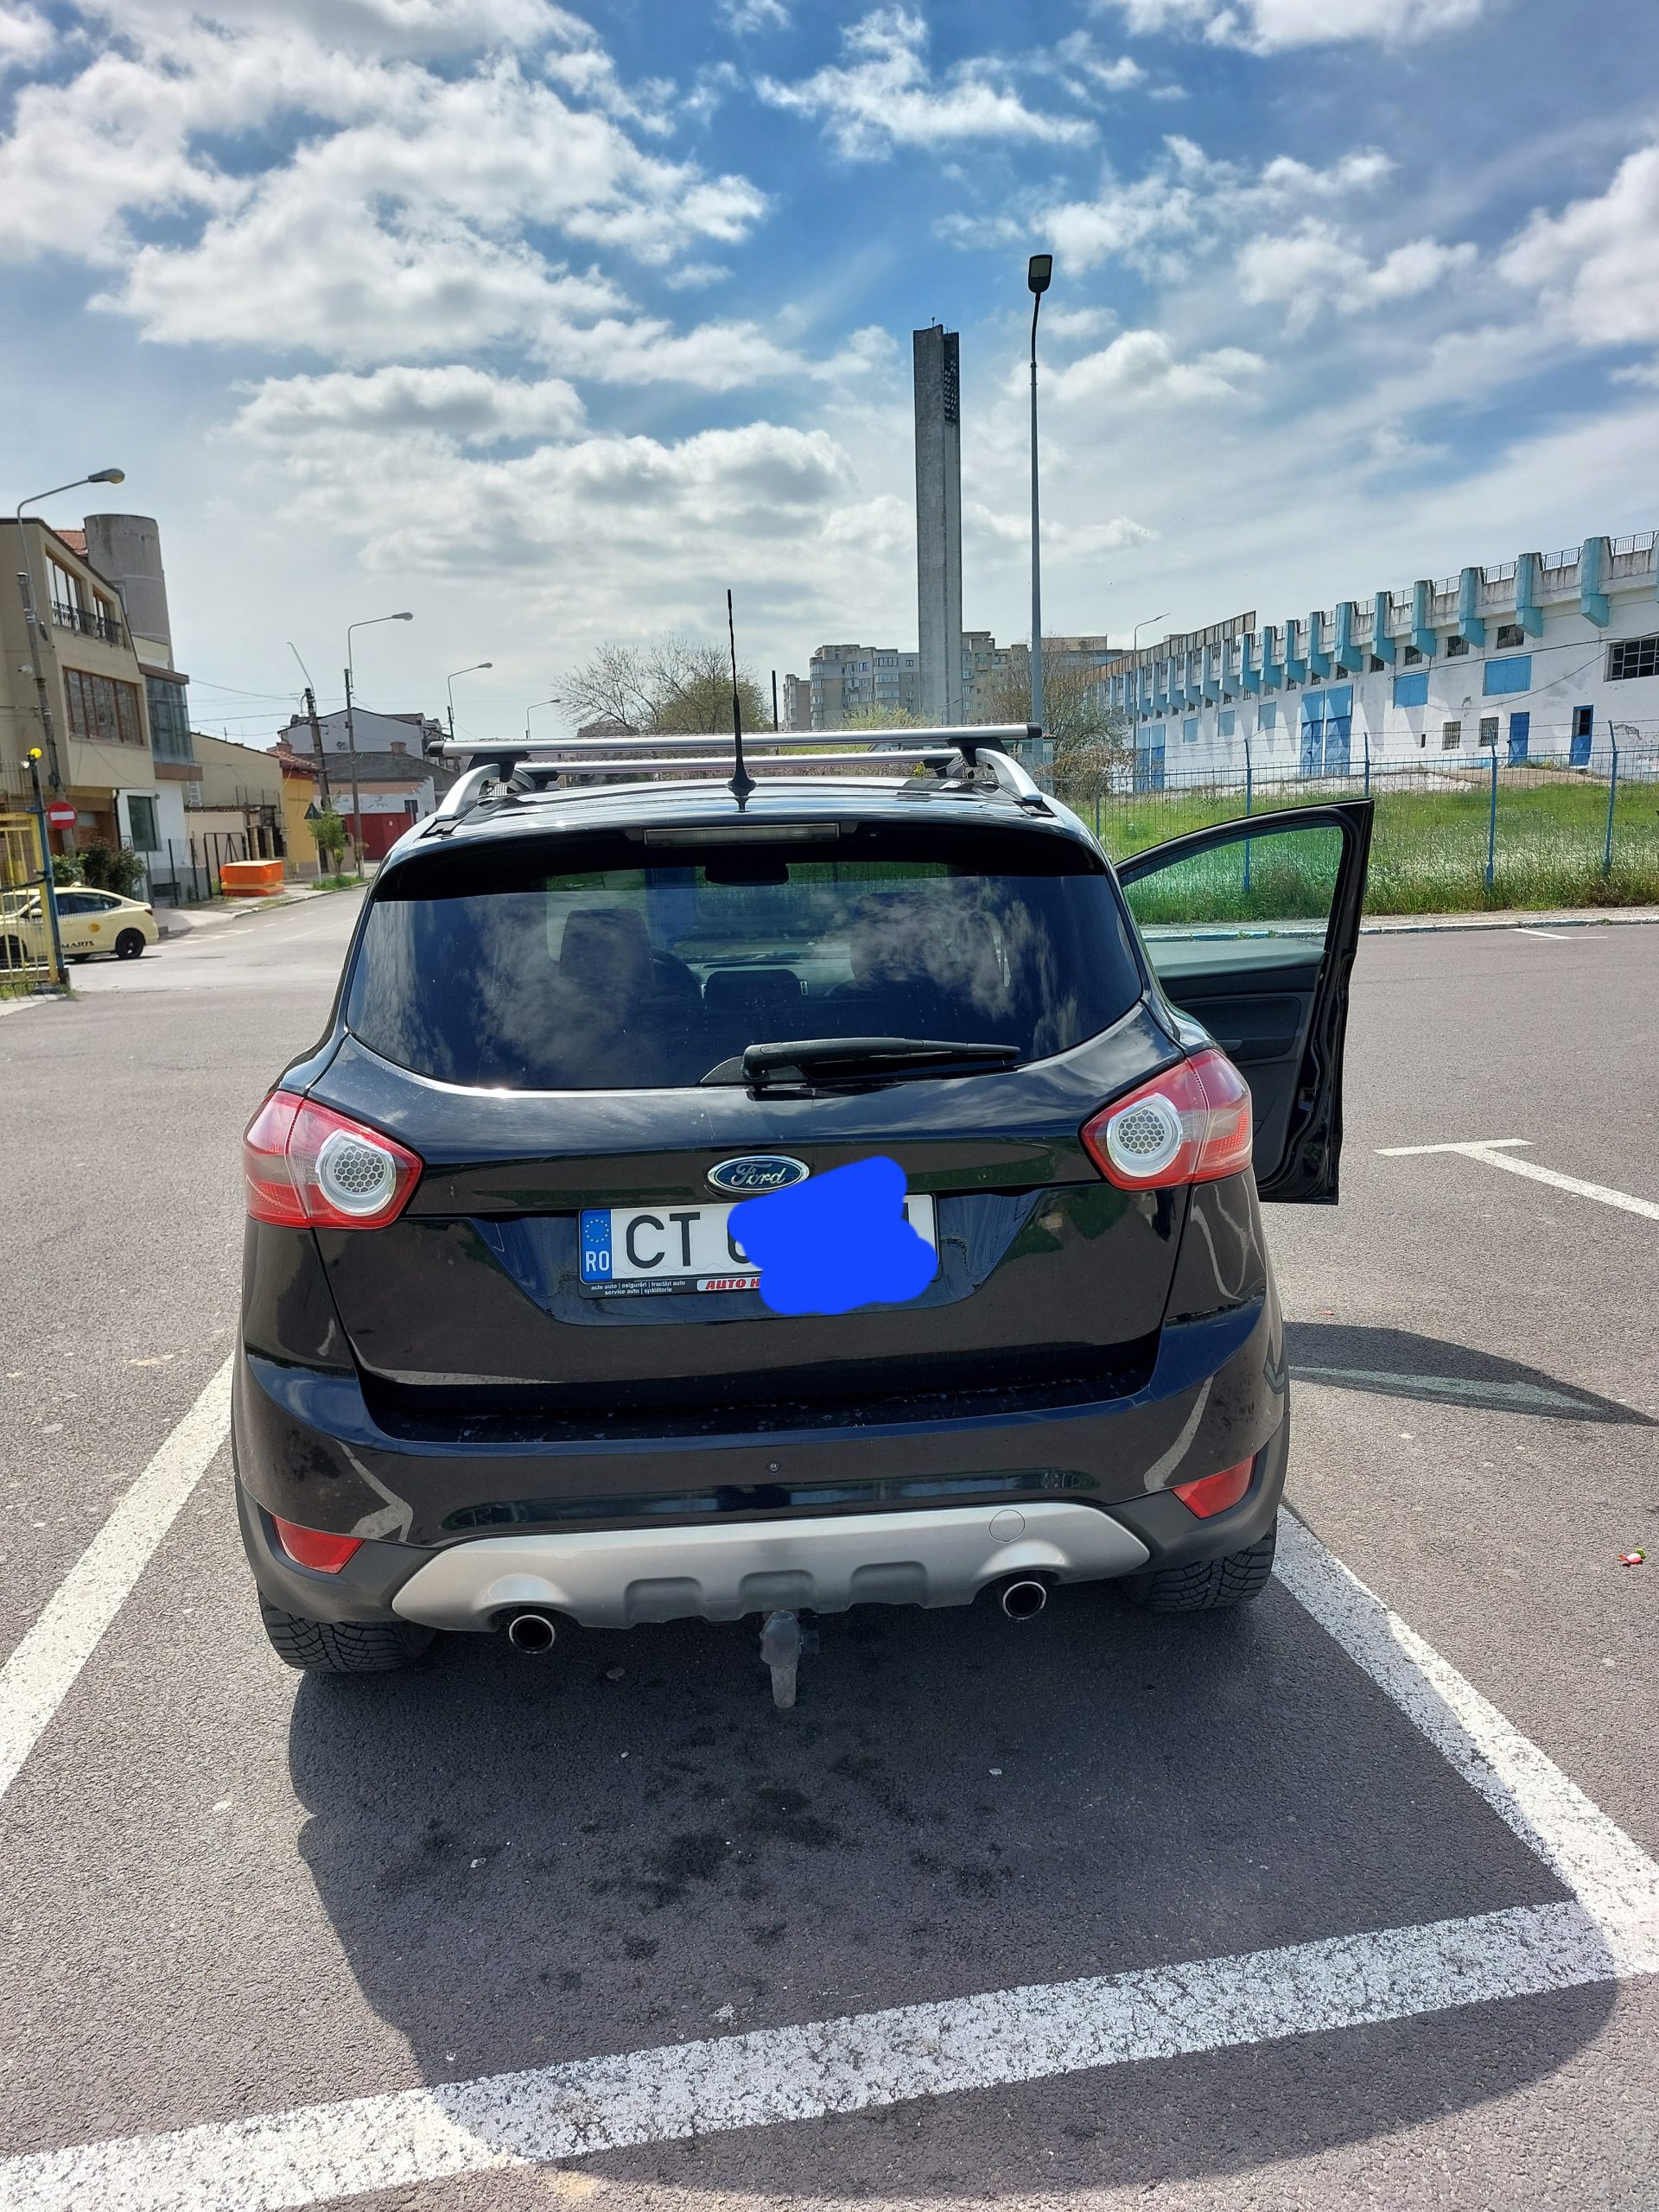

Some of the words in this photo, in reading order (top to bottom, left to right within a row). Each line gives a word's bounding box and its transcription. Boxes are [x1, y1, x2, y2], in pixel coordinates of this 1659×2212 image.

[730, 1163, 787, 1185] Ford
[626, 1211, 701, 1269] CT
[585, 1250, 610, 1272] RO
[705, 1279, 747, 1290] AUTO
